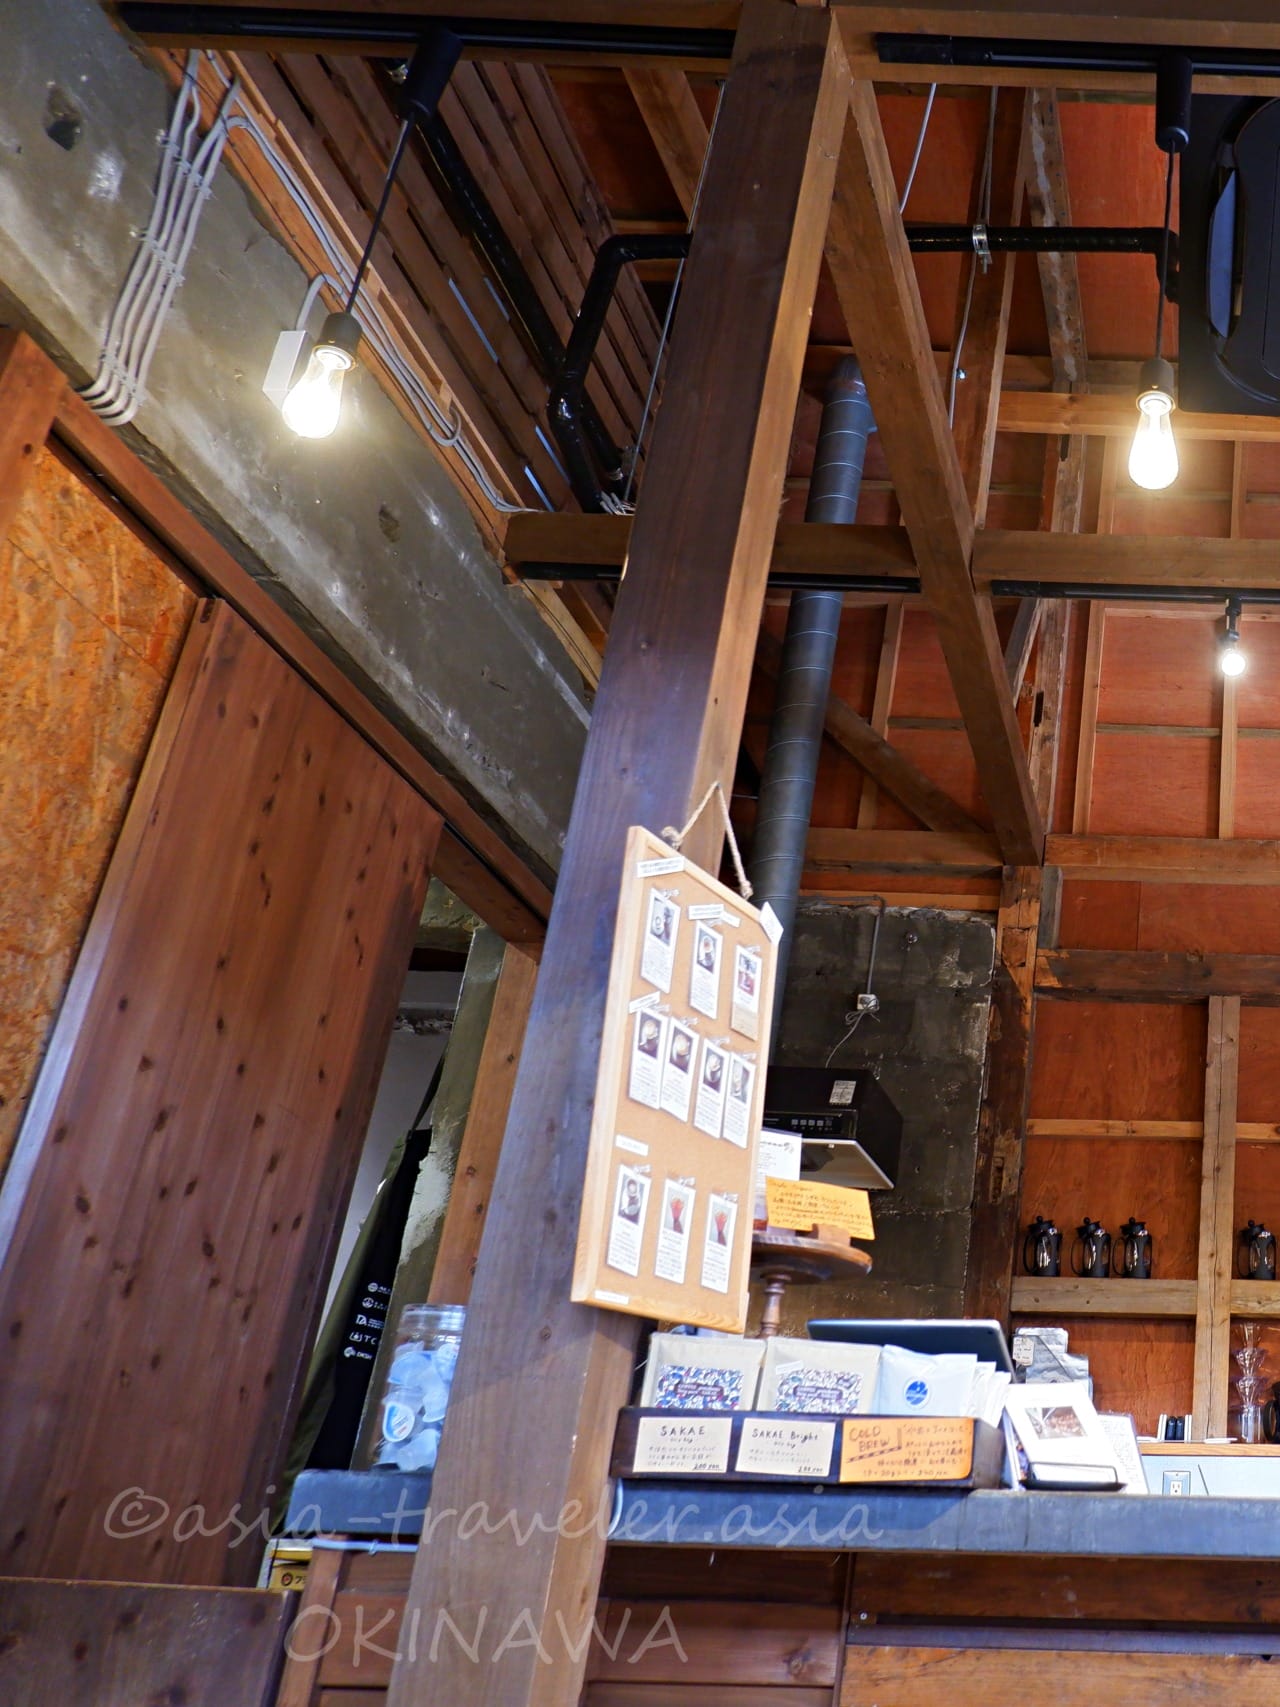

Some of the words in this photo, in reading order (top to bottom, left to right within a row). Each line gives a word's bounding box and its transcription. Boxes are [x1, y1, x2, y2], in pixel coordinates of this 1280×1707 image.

[660, 1425, 706, 1437] SAKAE
[751, 1428, 784, 1438] SAKAE
[790, 1431, 818, 1444] Bright
[848, 1425, 881, 1441] COLD
[859, 1438, 890, 1452] BREW
